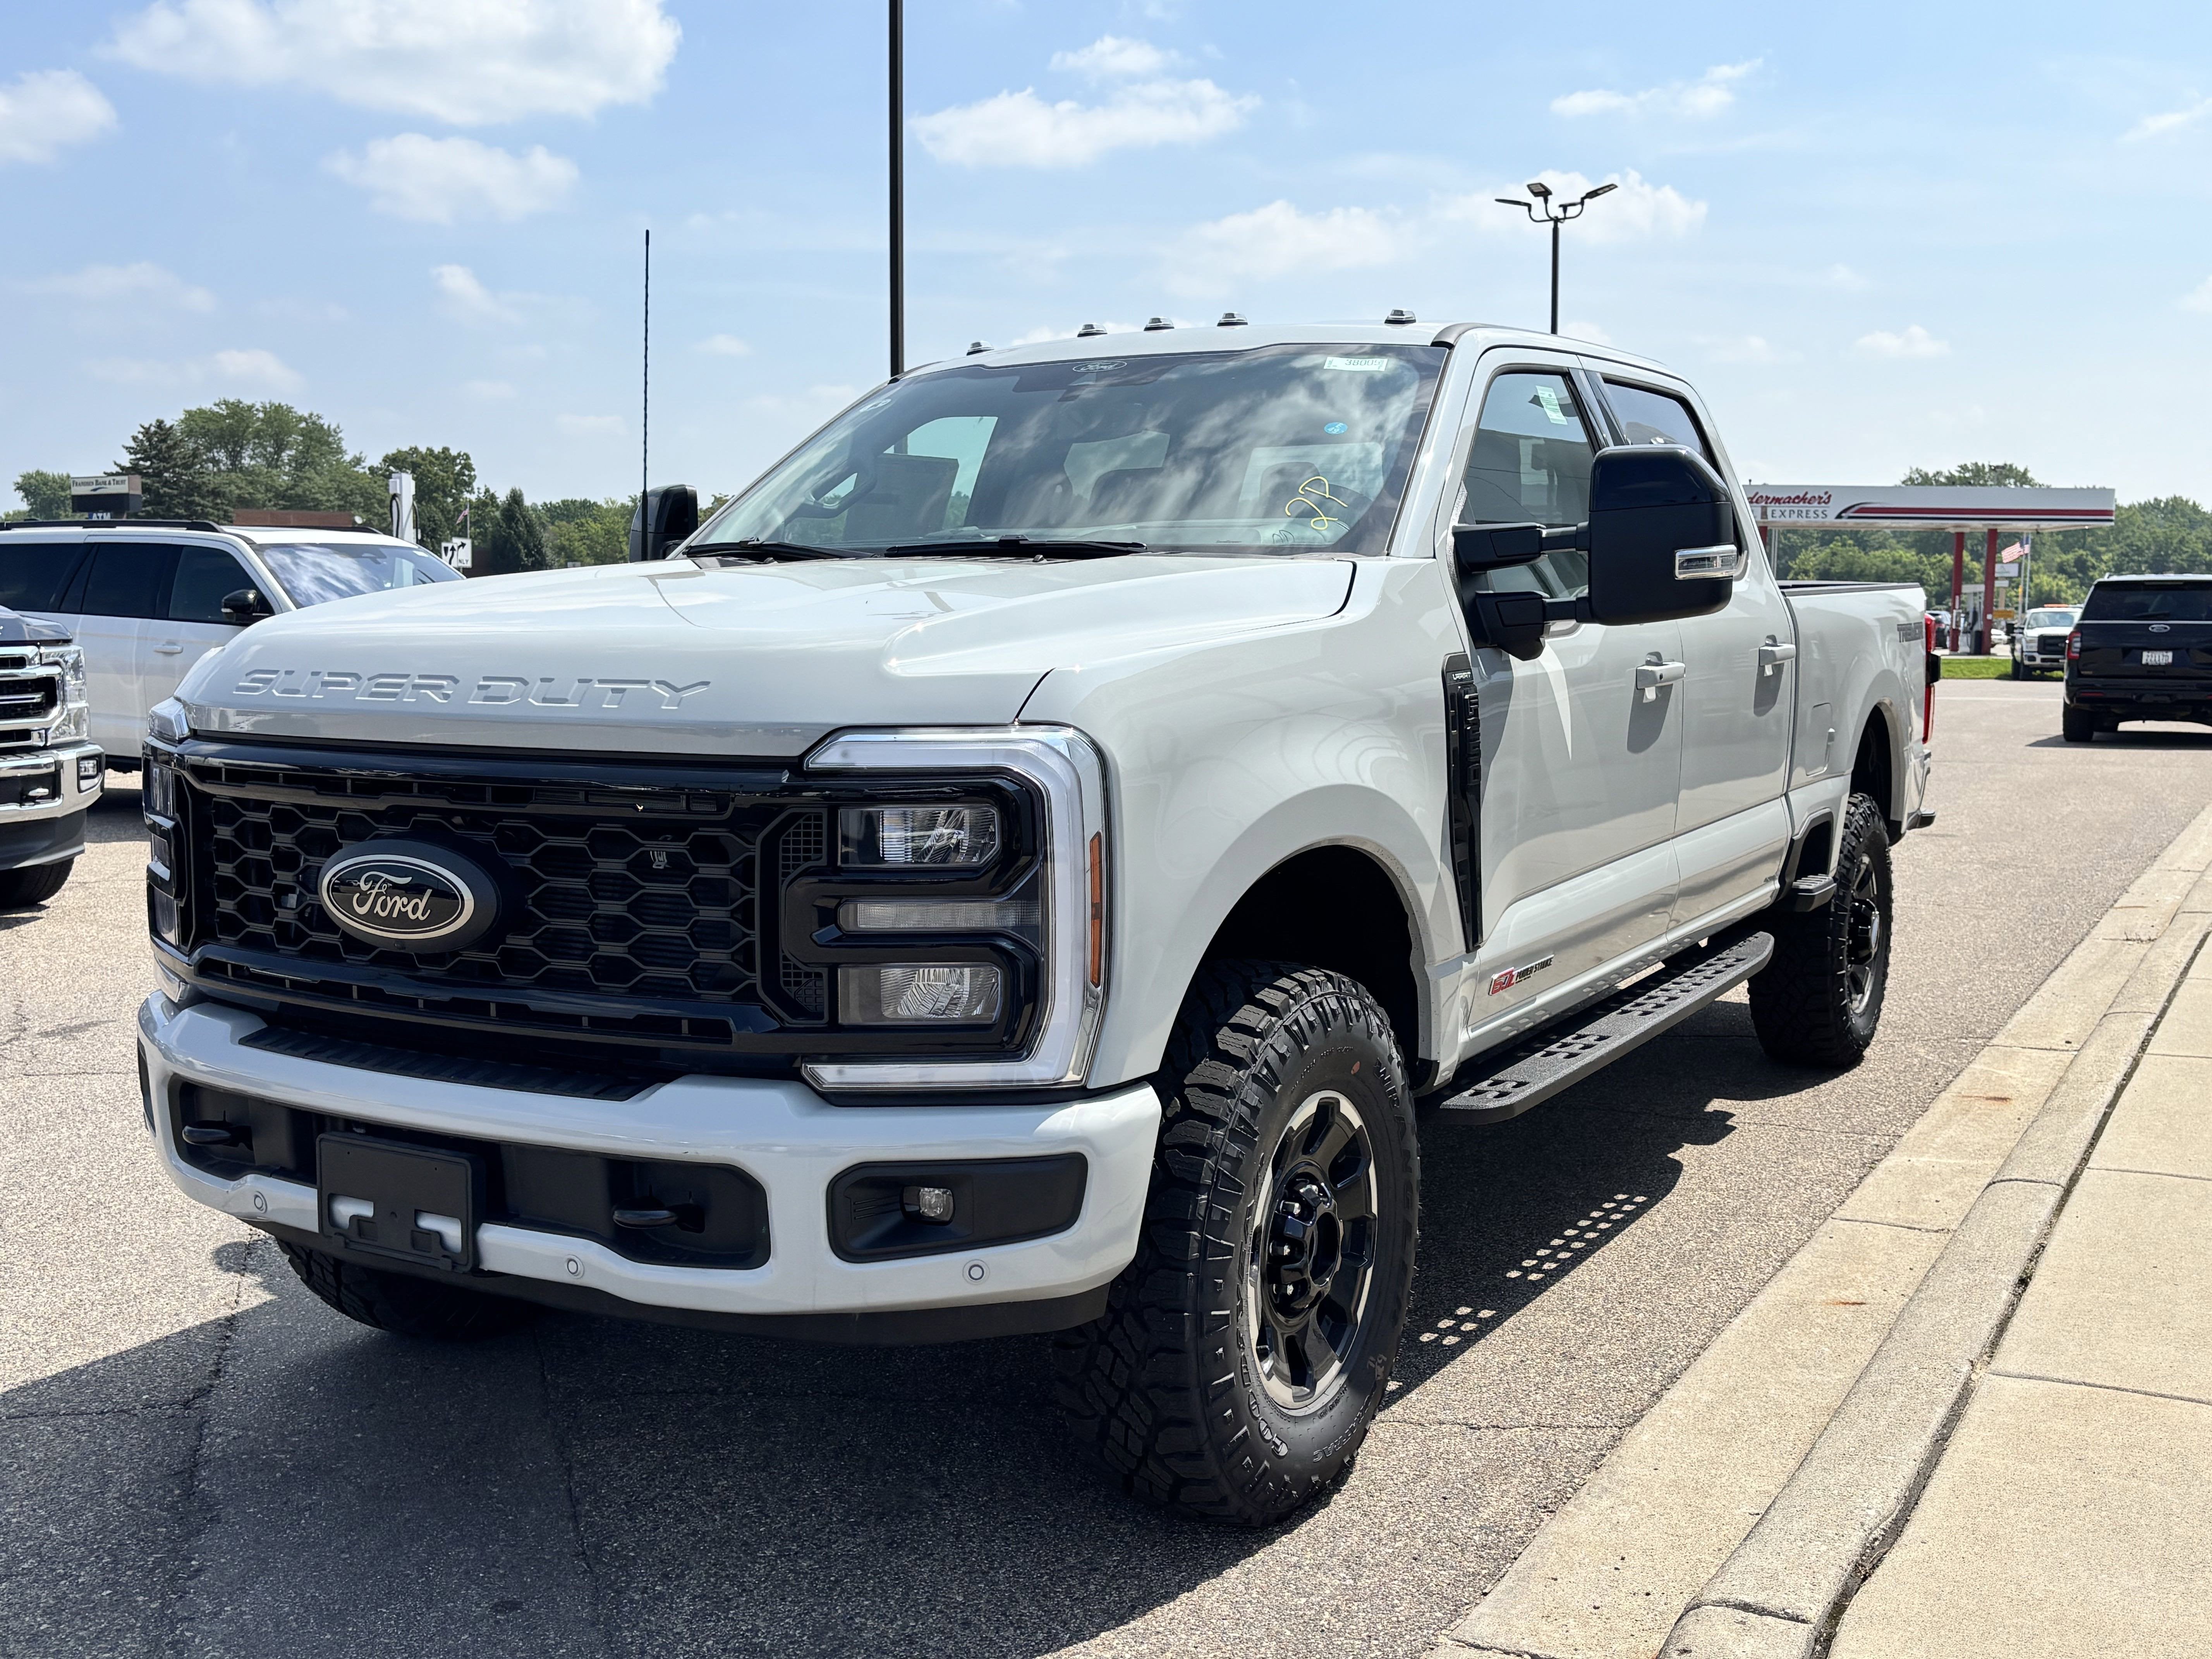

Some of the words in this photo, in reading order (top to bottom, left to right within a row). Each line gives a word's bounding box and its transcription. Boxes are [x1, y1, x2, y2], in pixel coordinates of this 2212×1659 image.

[1748, 491, 1832, 505] dermacher's
[1771, 509, 1828, 519] EXPRESS
[232, 669, 460, 704] SUPER
[468, 676, 711, 709] DUTY
[352, 871, 431, 921] Ford
